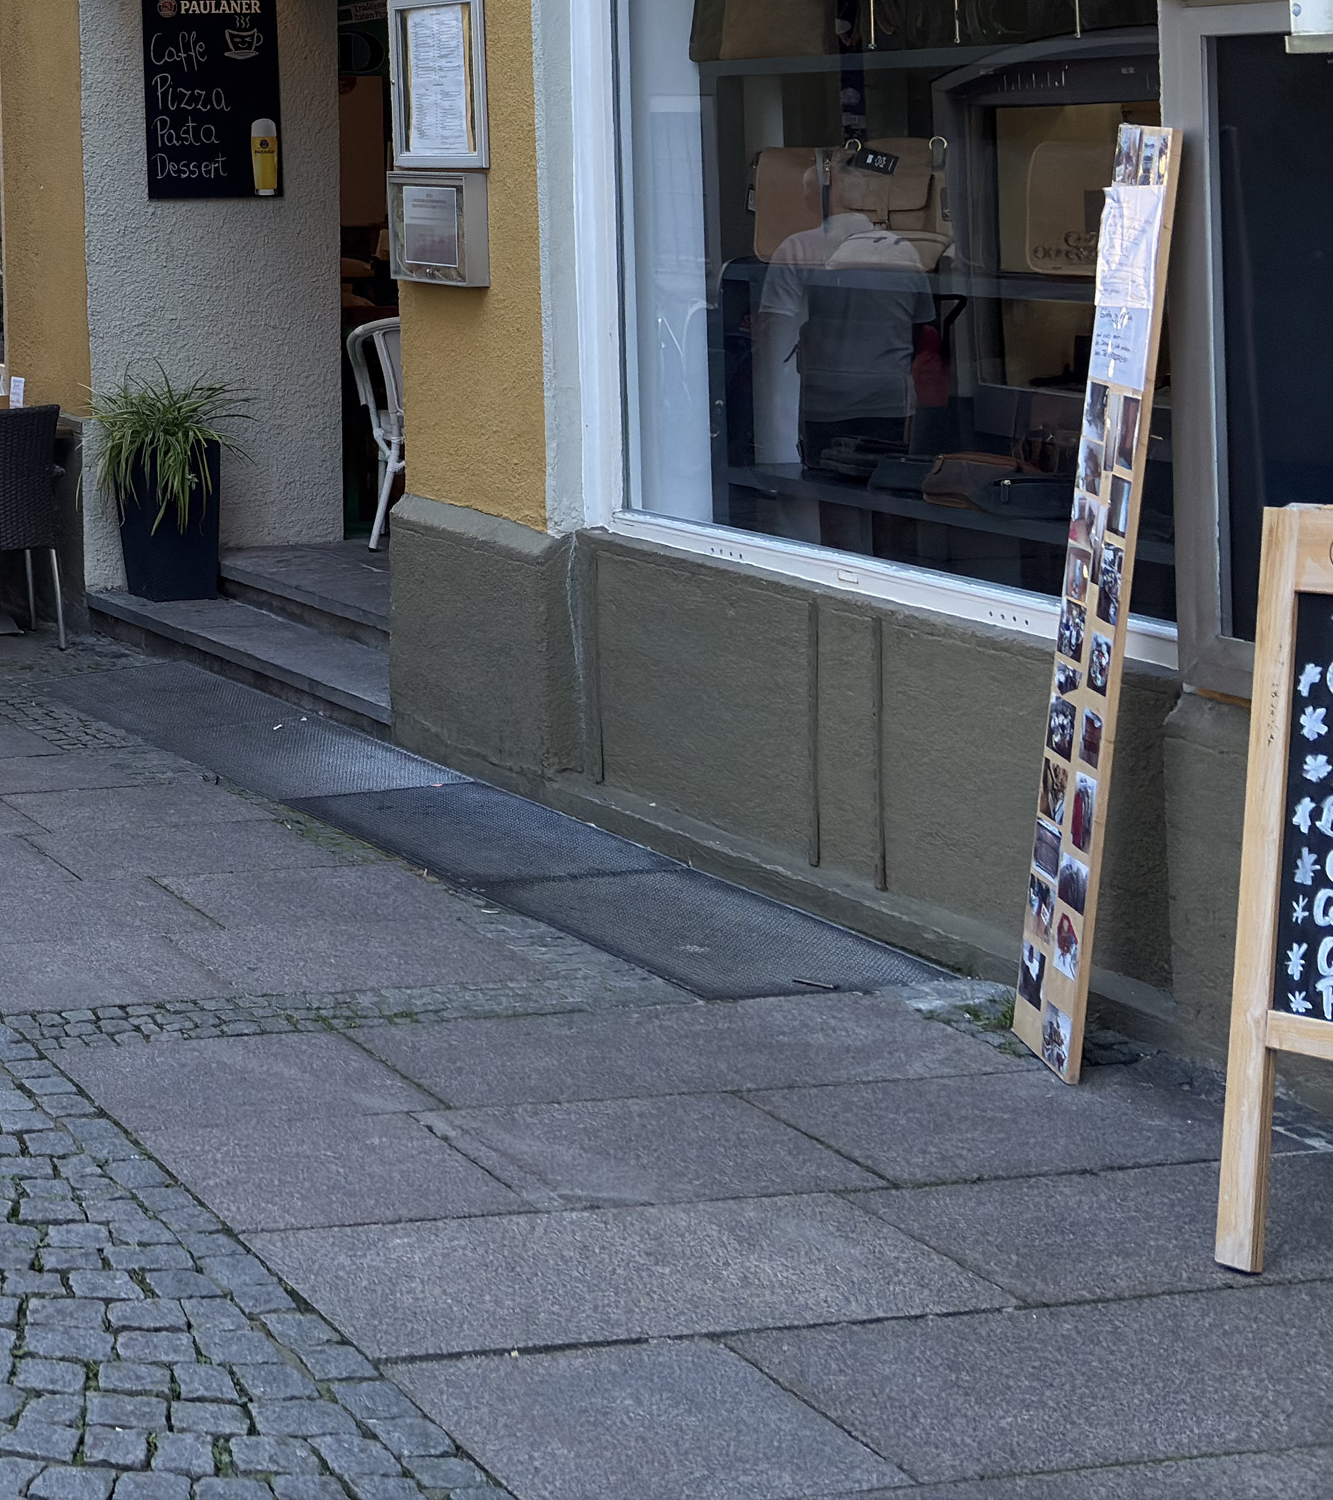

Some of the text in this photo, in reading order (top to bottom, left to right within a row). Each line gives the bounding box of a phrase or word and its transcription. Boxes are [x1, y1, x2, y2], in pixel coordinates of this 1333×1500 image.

[180, 0, 261, 14] PAULANER
[151, 73, 231, 112] Pizza
[150, 116, 221, 147] Pasta
[150, 152, 228, 180] Dessert
